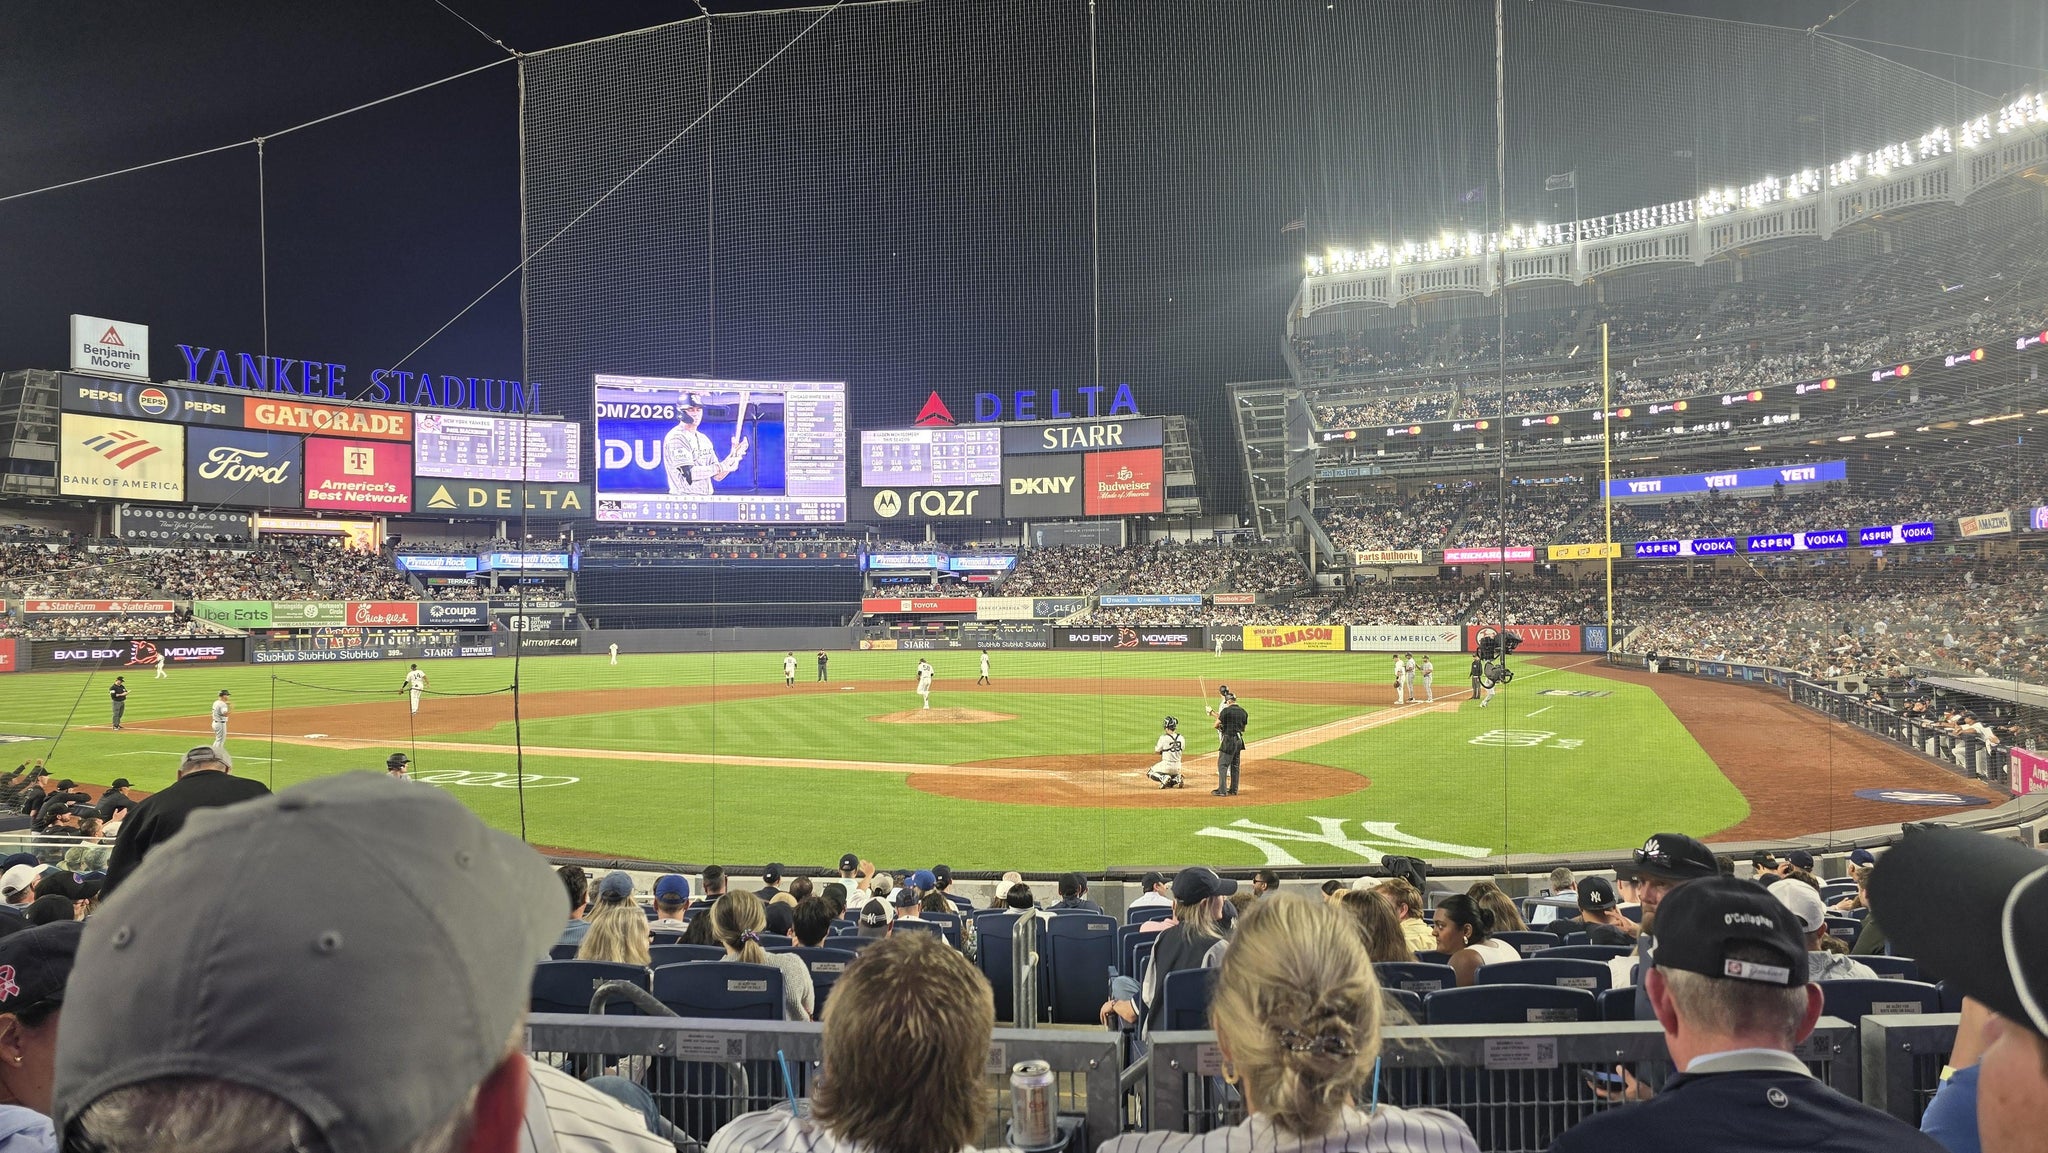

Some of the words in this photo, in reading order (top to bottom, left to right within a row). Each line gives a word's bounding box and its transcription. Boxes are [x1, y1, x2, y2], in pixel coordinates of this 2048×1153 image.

[83, 343, 140, 361] Benjamin
[91, 355, 131, 370] Moore
[175, 344, 347, 400] YANKEE
[370, 368, 542, 414] STADIUM
[79, 388, 123, 403] PEPSI
[141, 396, 166, 406] PEPSI
[184, 401, 226, 414] PEPSI
[976, 383, 1139, 422] DELTA
[255, 404, 404, 435] GATORADE
[1042, 424, 1123, 450] STARR
[199, 446, 291, 484] Ford
[1704, 474, 1738, 488] YETI
[1780, 467, 1816, 482] YETI
[63, 475, 98, 486] BANK
[103, 478, 119, 487] OF
[121, 479, 179, 491] AMERICA
[320, 479, 396, 493] America's
[1009, 476, 1076, 495] DKNY
[1098, 481, 1151, 493] Budweiser
[1628, 480, 1662, 493] YETI
[308, 490, 342, 502] Best
[345, 491, 408, 504] Network
[468, 487, 582, 510] DELTA
[908, 490, 979, 516] razr
[1978, 517, 2008, 530] AMAZING
[1862, 531, 1892, 541] ASPEN
[1902, 527, 1933, 538] VODKA
[1637, 544, 1677, 554] ASPEN
[1694, 541, 1733, 552] VODKA
[1752, 538, 1792, 549] ASPEN
[1806, 534, 1844, 546] VODKA
[406, 557, 444, 566] Plymouth
[446, 558, 466, 566] Rock
[500, 553, 538, 564] Plymouth
[540, 554, 561, 563] Rock
[876, 555, 911, 564] Plymouth
[911, 555, 929, 563] Rock
[957, 557, 990, 567] Plymouth
[991, 557, 1007, 566] Rock
[1359, 553, 1379, 561] Parts
[1381, 551, 1418, 561] Authority
[197, 608, 230, 621] Uber
[234, 609, 268, 620] Eats
[445, 605, 477, 617] coupa
[1092, 634, 1114, 642] BOY
[1142, 634, 1188, 642] MOWERS
[1531, 628, 1571, 641] WEBB
[1587, 635, 1605, 643] YORK
[522, 638, 578, 648] NITTOTIRE.COM
[904, 640, 930, 649] STARR
[54, 649, 88, 660] BAD
[91, 648, 124, 659] BOY
[164, 646, 225, 657] MOWERS
[257, 653, 295, 662] StubHub
[297, 651, 337, 661] StubHub
[339, 650, 379, 660] StubHub
[424, 648, 454, 657] STARR
[1590, 890, 1602, 903] NY
[866, 912, 877, 926] NY
[1724, 912, 1774, 929] O'Callaghan
